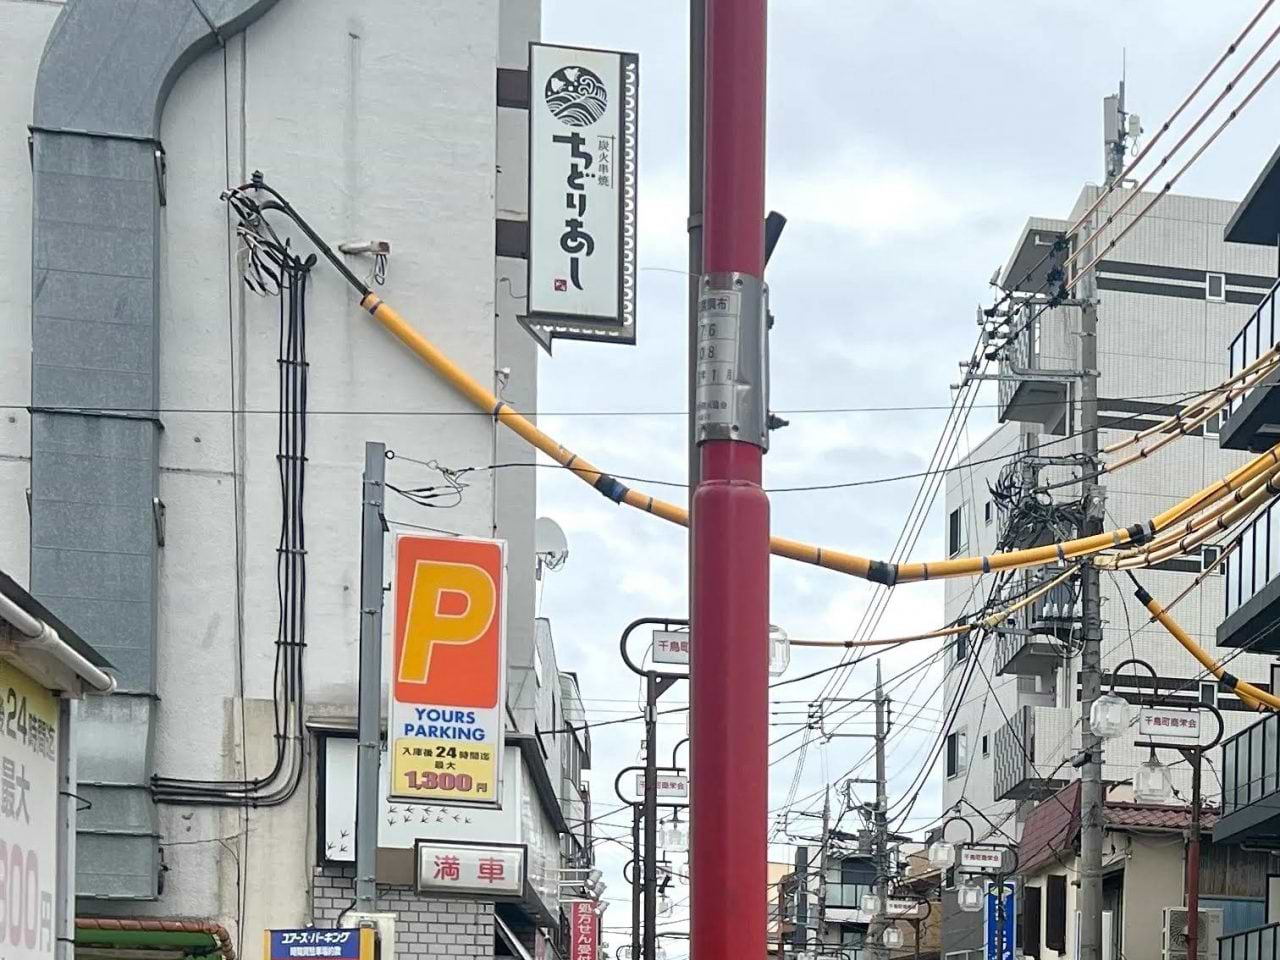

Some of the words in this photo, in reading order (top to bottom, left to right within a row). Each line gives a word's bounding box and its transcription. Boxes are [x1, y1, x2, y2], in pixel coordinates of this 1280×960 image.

[598, 139, 610, 188] 炭火串焼
[397, 559, 497, 685] P
[415, 707, 476, 725] YOURS
[1145, 715, 1197, 729] 千鳥町商栄会
[403, 722, 486, 742] PARKING
[433, 853, 506, 884] 満車
